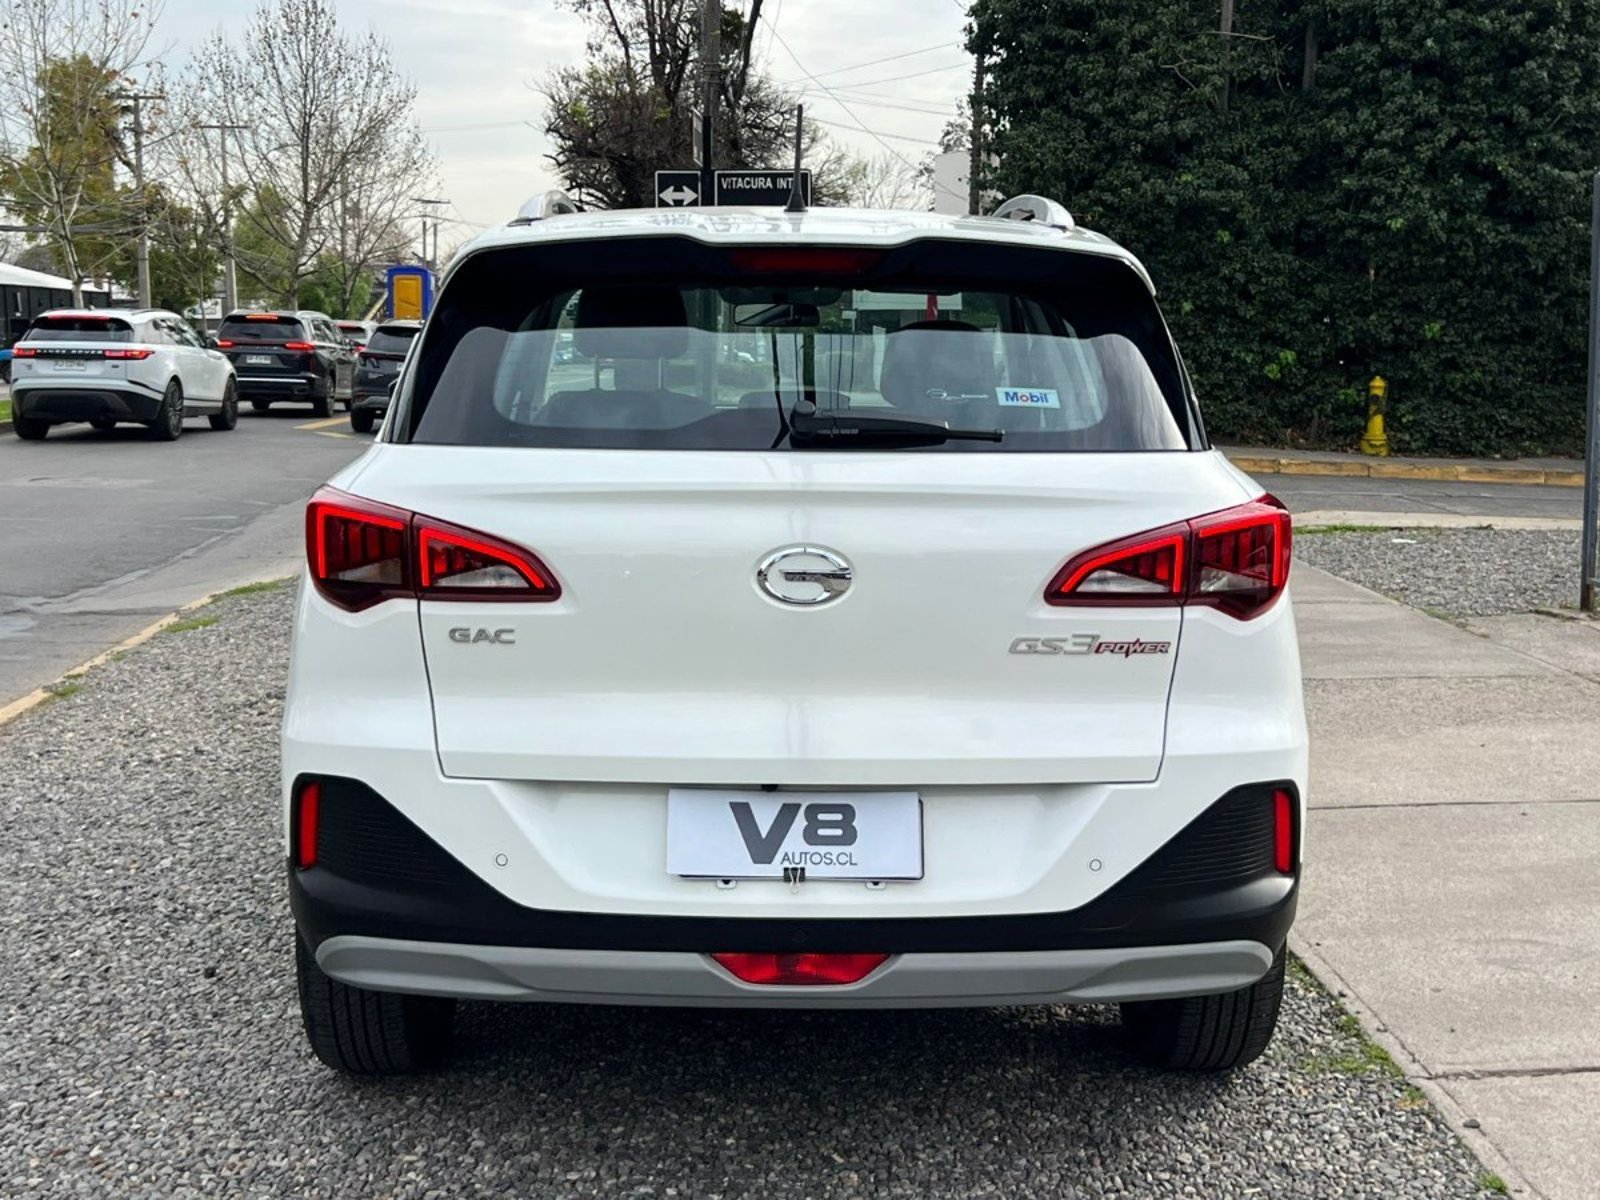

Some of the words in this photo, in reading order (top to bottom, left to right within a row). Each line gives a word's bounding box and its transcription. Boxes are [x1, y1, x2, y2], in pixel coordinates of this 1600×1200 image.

[720, 176, 773, 190] VITACURA
[1004, 391, 1049, 403] Mobil
[448, 627, 516, 644] GAC
[1008, 634, 1101, 655] GS3
[1095, 638, 1170, 658] POWER
[728, 801, 858, 865] V8
[780, 852, 858, 866] AUTOS.CL
